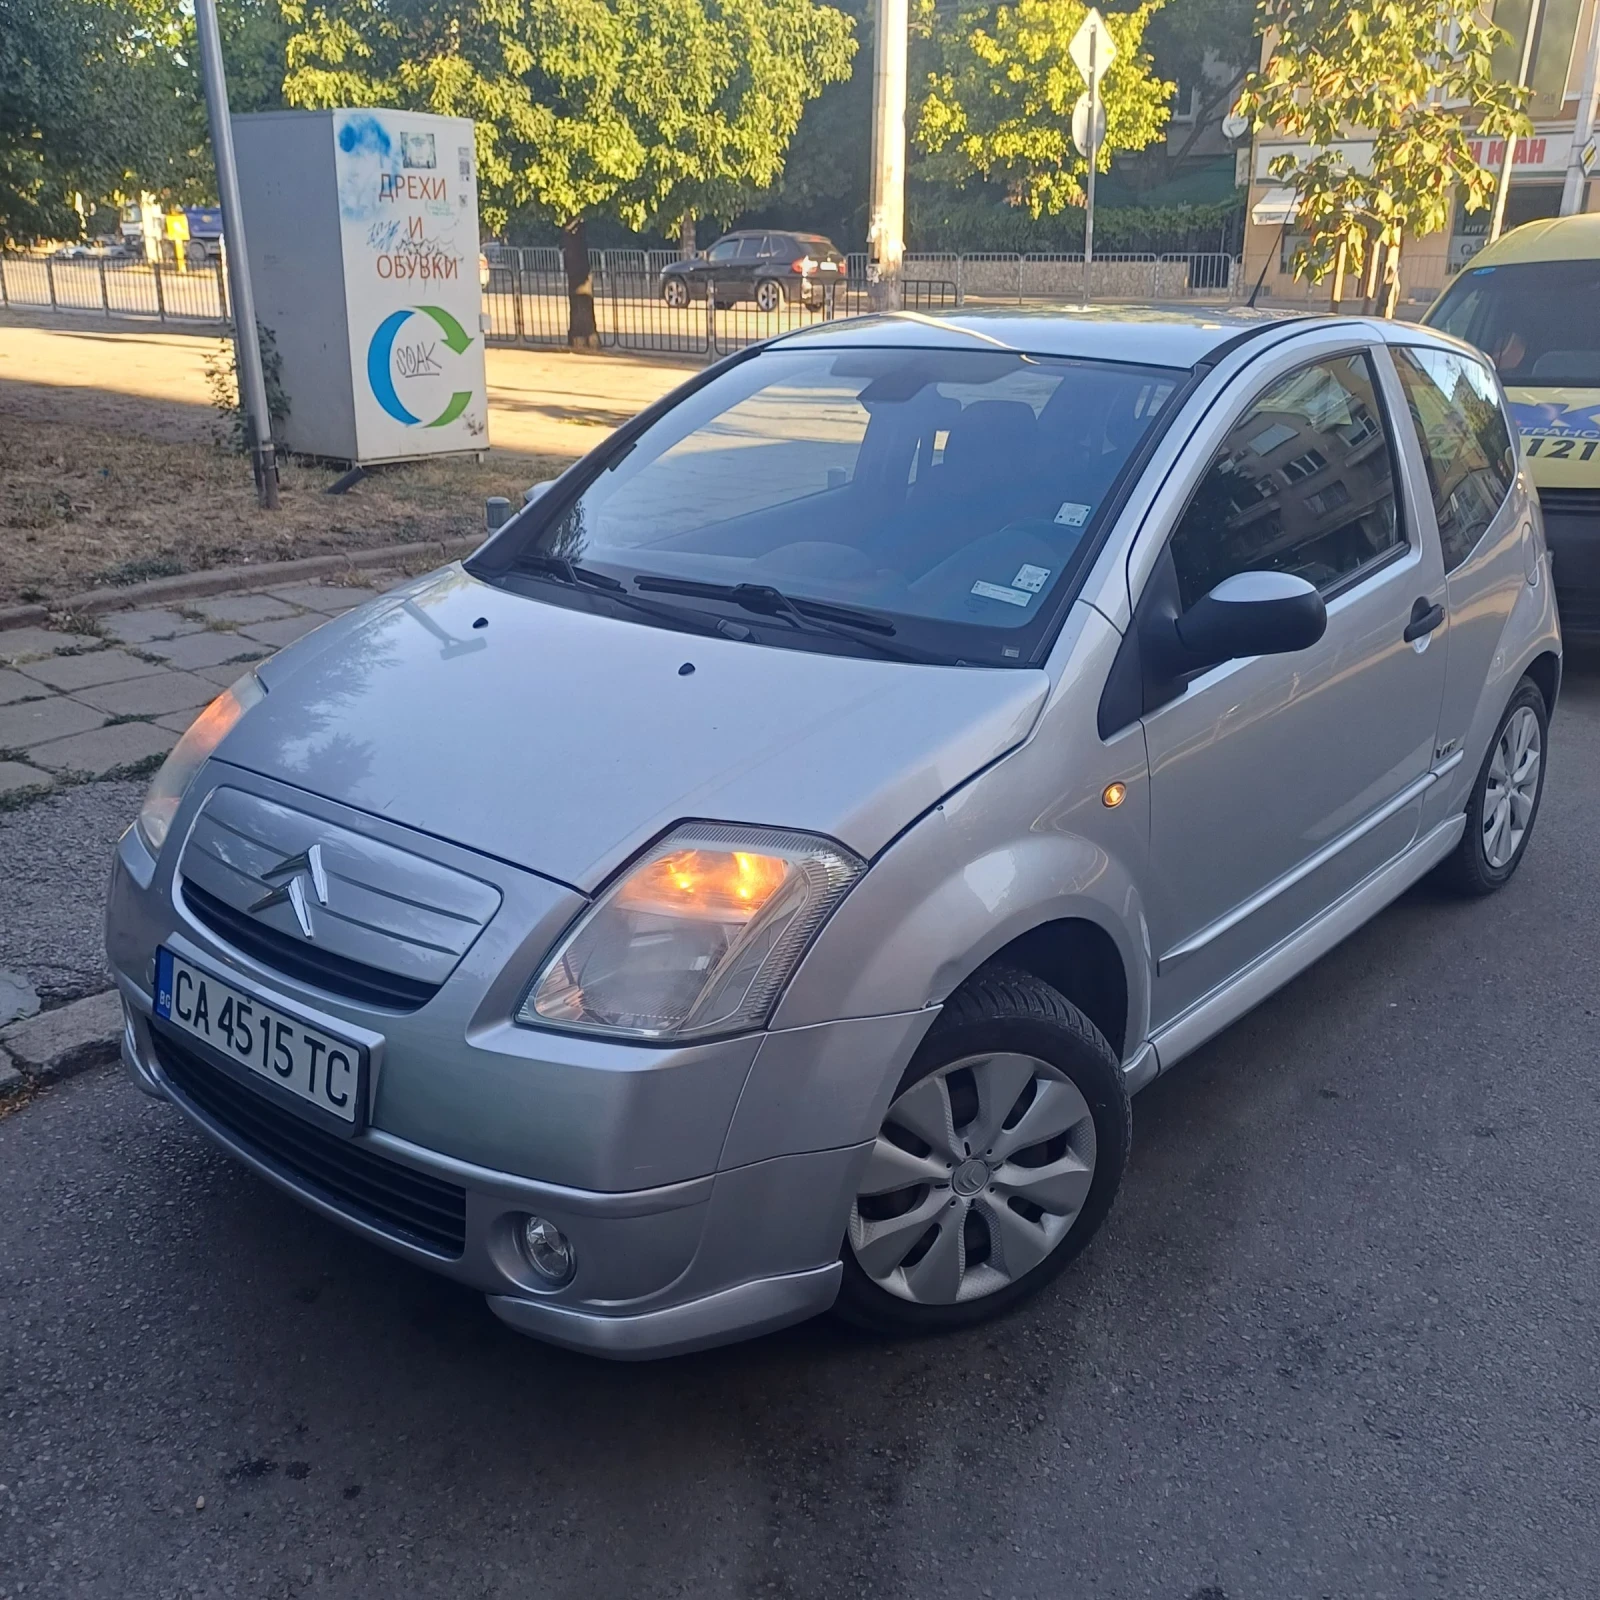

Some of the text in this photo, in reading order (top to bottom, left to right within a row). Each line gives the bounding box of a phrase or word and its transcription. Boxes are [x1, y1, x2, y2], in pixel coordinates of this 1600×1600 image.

[379, 173, 446, 203] ДРЕХИ
[408, 216, 423, 239] И
[376, 254, 458, 279] ОБУВКИ
[1526, 438, 1599, 461] 121
[159, 990, 171, 1007] BG
[175, 970, 350, 1107] CA 4515 TC
